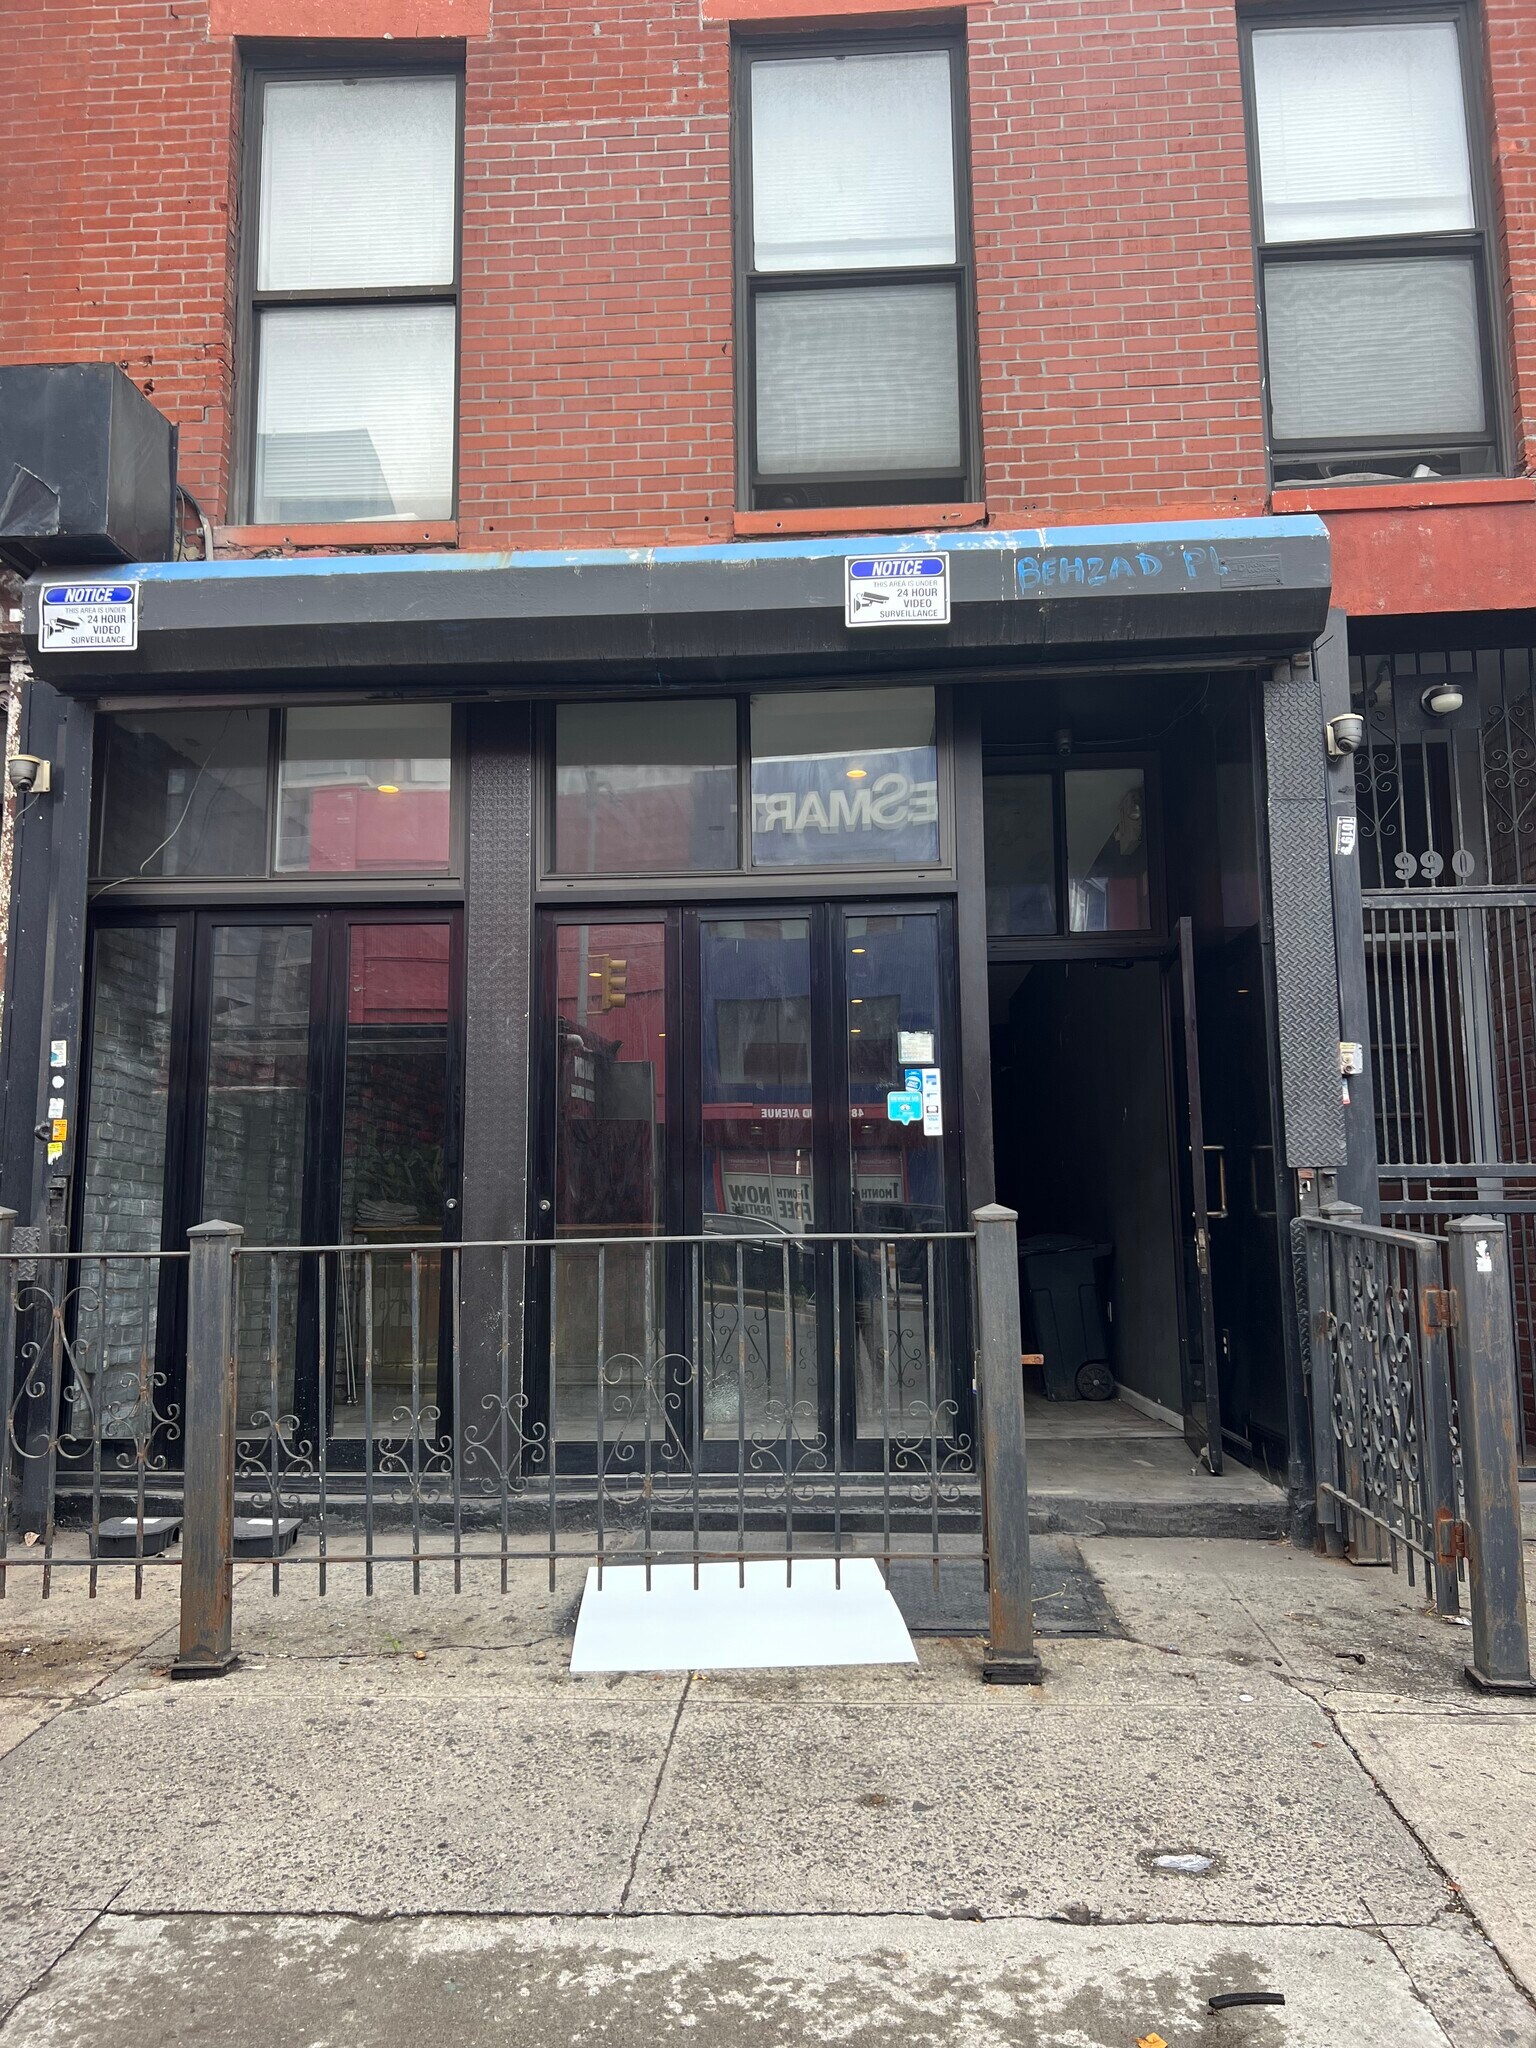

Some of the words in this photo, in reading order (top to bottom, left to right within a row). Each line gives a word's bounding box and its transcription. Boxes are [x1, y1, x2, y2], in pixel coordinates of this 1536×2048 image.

[871, 560, 923, 576] NOTICE
[873, 580, 888, 588] THIS
[915, 579, 938, 587] UNDER
[64, 588, 115, 603] NOTICE
[897, 588, 908, 597] 24
[911, 587, 938, 597] HOUR
[903, 598, 932, 608] VIDEO
[65, 606, 79, 614] THIS
[80, 606, 96, 614] AREA
[880, 608, 938, 619] SURVEILLANCE
[87, 615, 98, 624] 24
[101, 614, 126, 623] HOUR
[93, 625, 120, 635] VIDEO
[71, 635, 126, 645] SURVEILLANCE
[1394, 849, 1476, 880] 990
